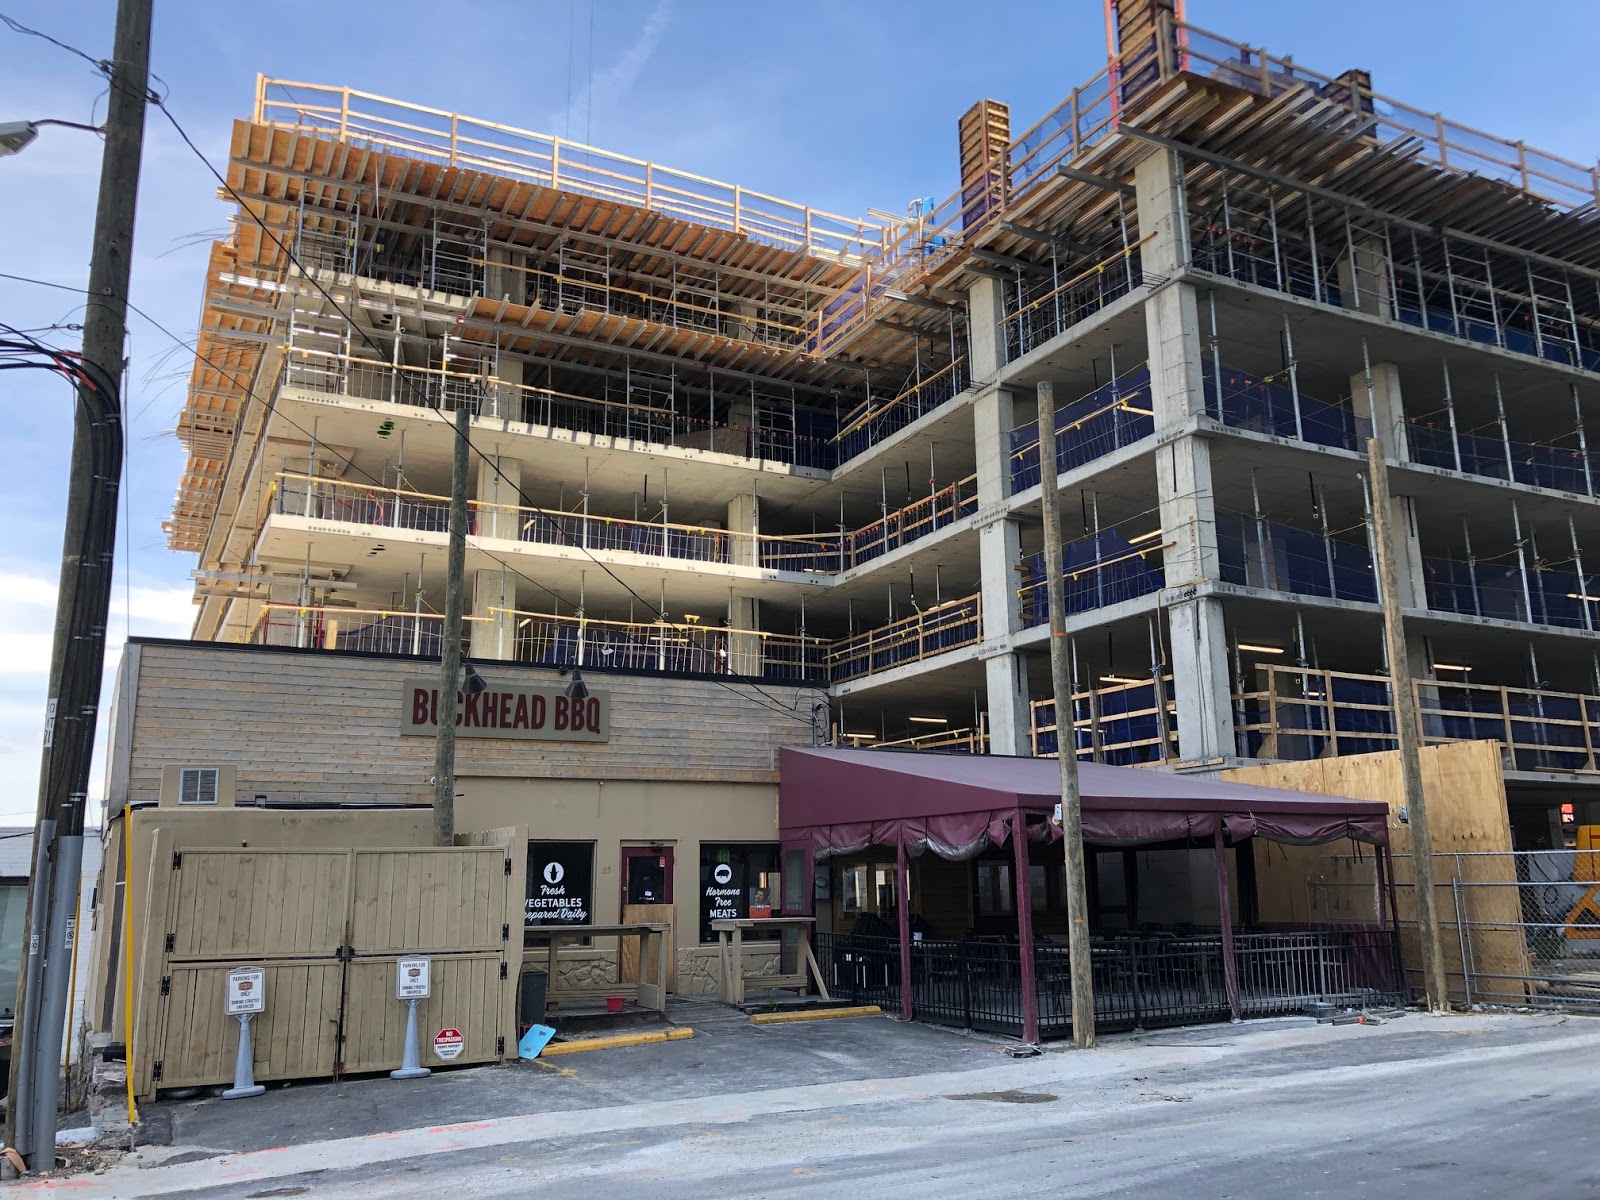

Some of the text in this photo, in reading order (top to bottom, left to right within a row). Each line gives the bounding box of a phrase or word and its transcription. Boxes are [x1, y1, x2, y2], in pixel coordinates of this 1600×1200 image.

[554, 694, 601, 735] BBQ
[540, 884, 566, 896] Fresh
[705, 886, 741, 897] Hormone
[714, 897, 733, 908] Free
[560, 908, 588, 921] Daily
[709, 908, 738, 919] MEATS
